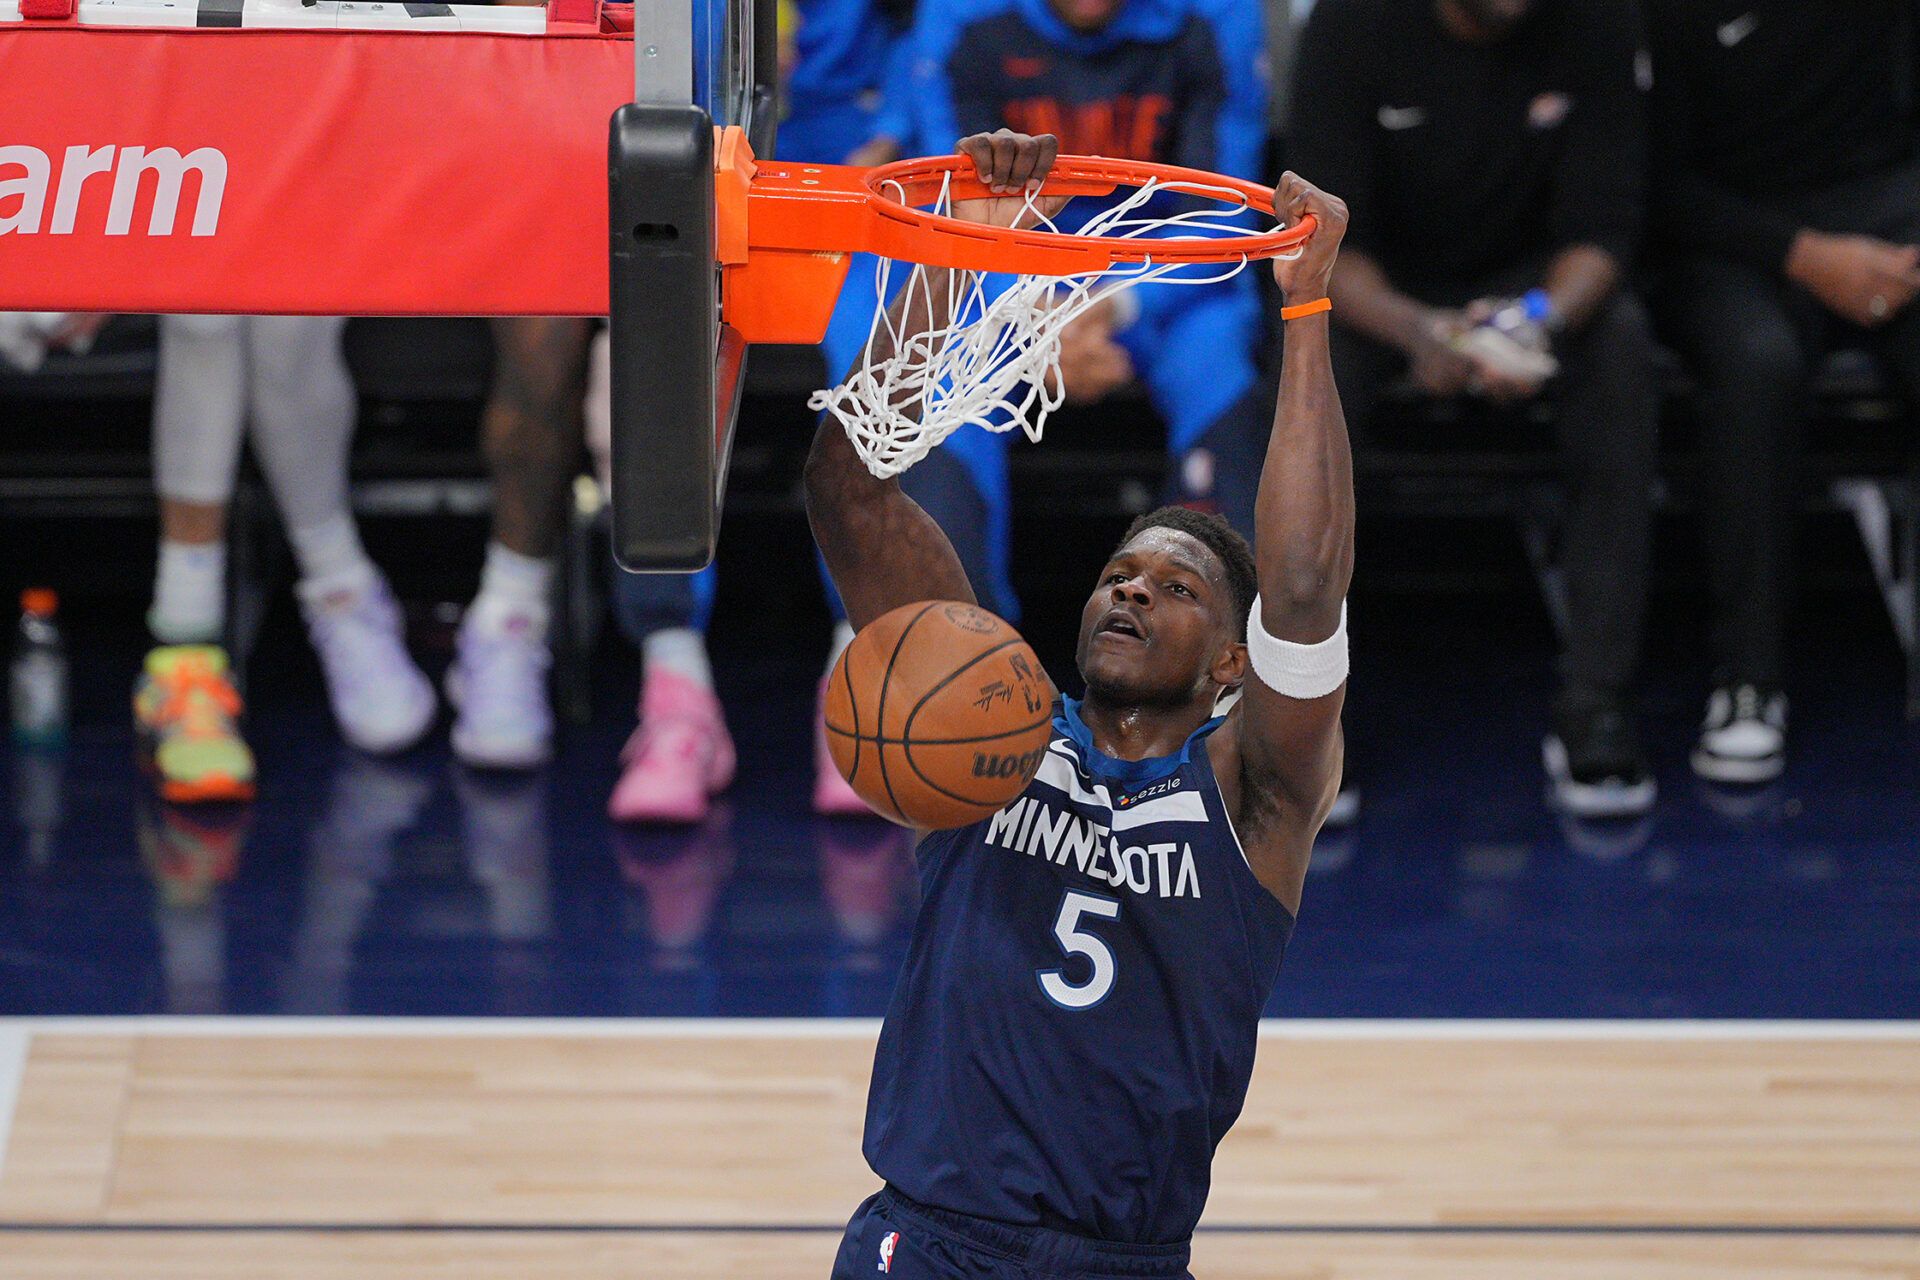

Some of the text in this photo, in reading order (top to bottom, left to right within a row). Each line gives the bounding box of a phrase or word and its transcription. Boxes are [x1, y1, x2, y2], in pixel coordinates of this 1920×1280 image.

[0, 145, 228, 236] arm
[1130, 778, 1181, 803] sezzle
[984, 797, 1201, 899] MINNESOTA
[1038, 889, 1121, 1009] 5
